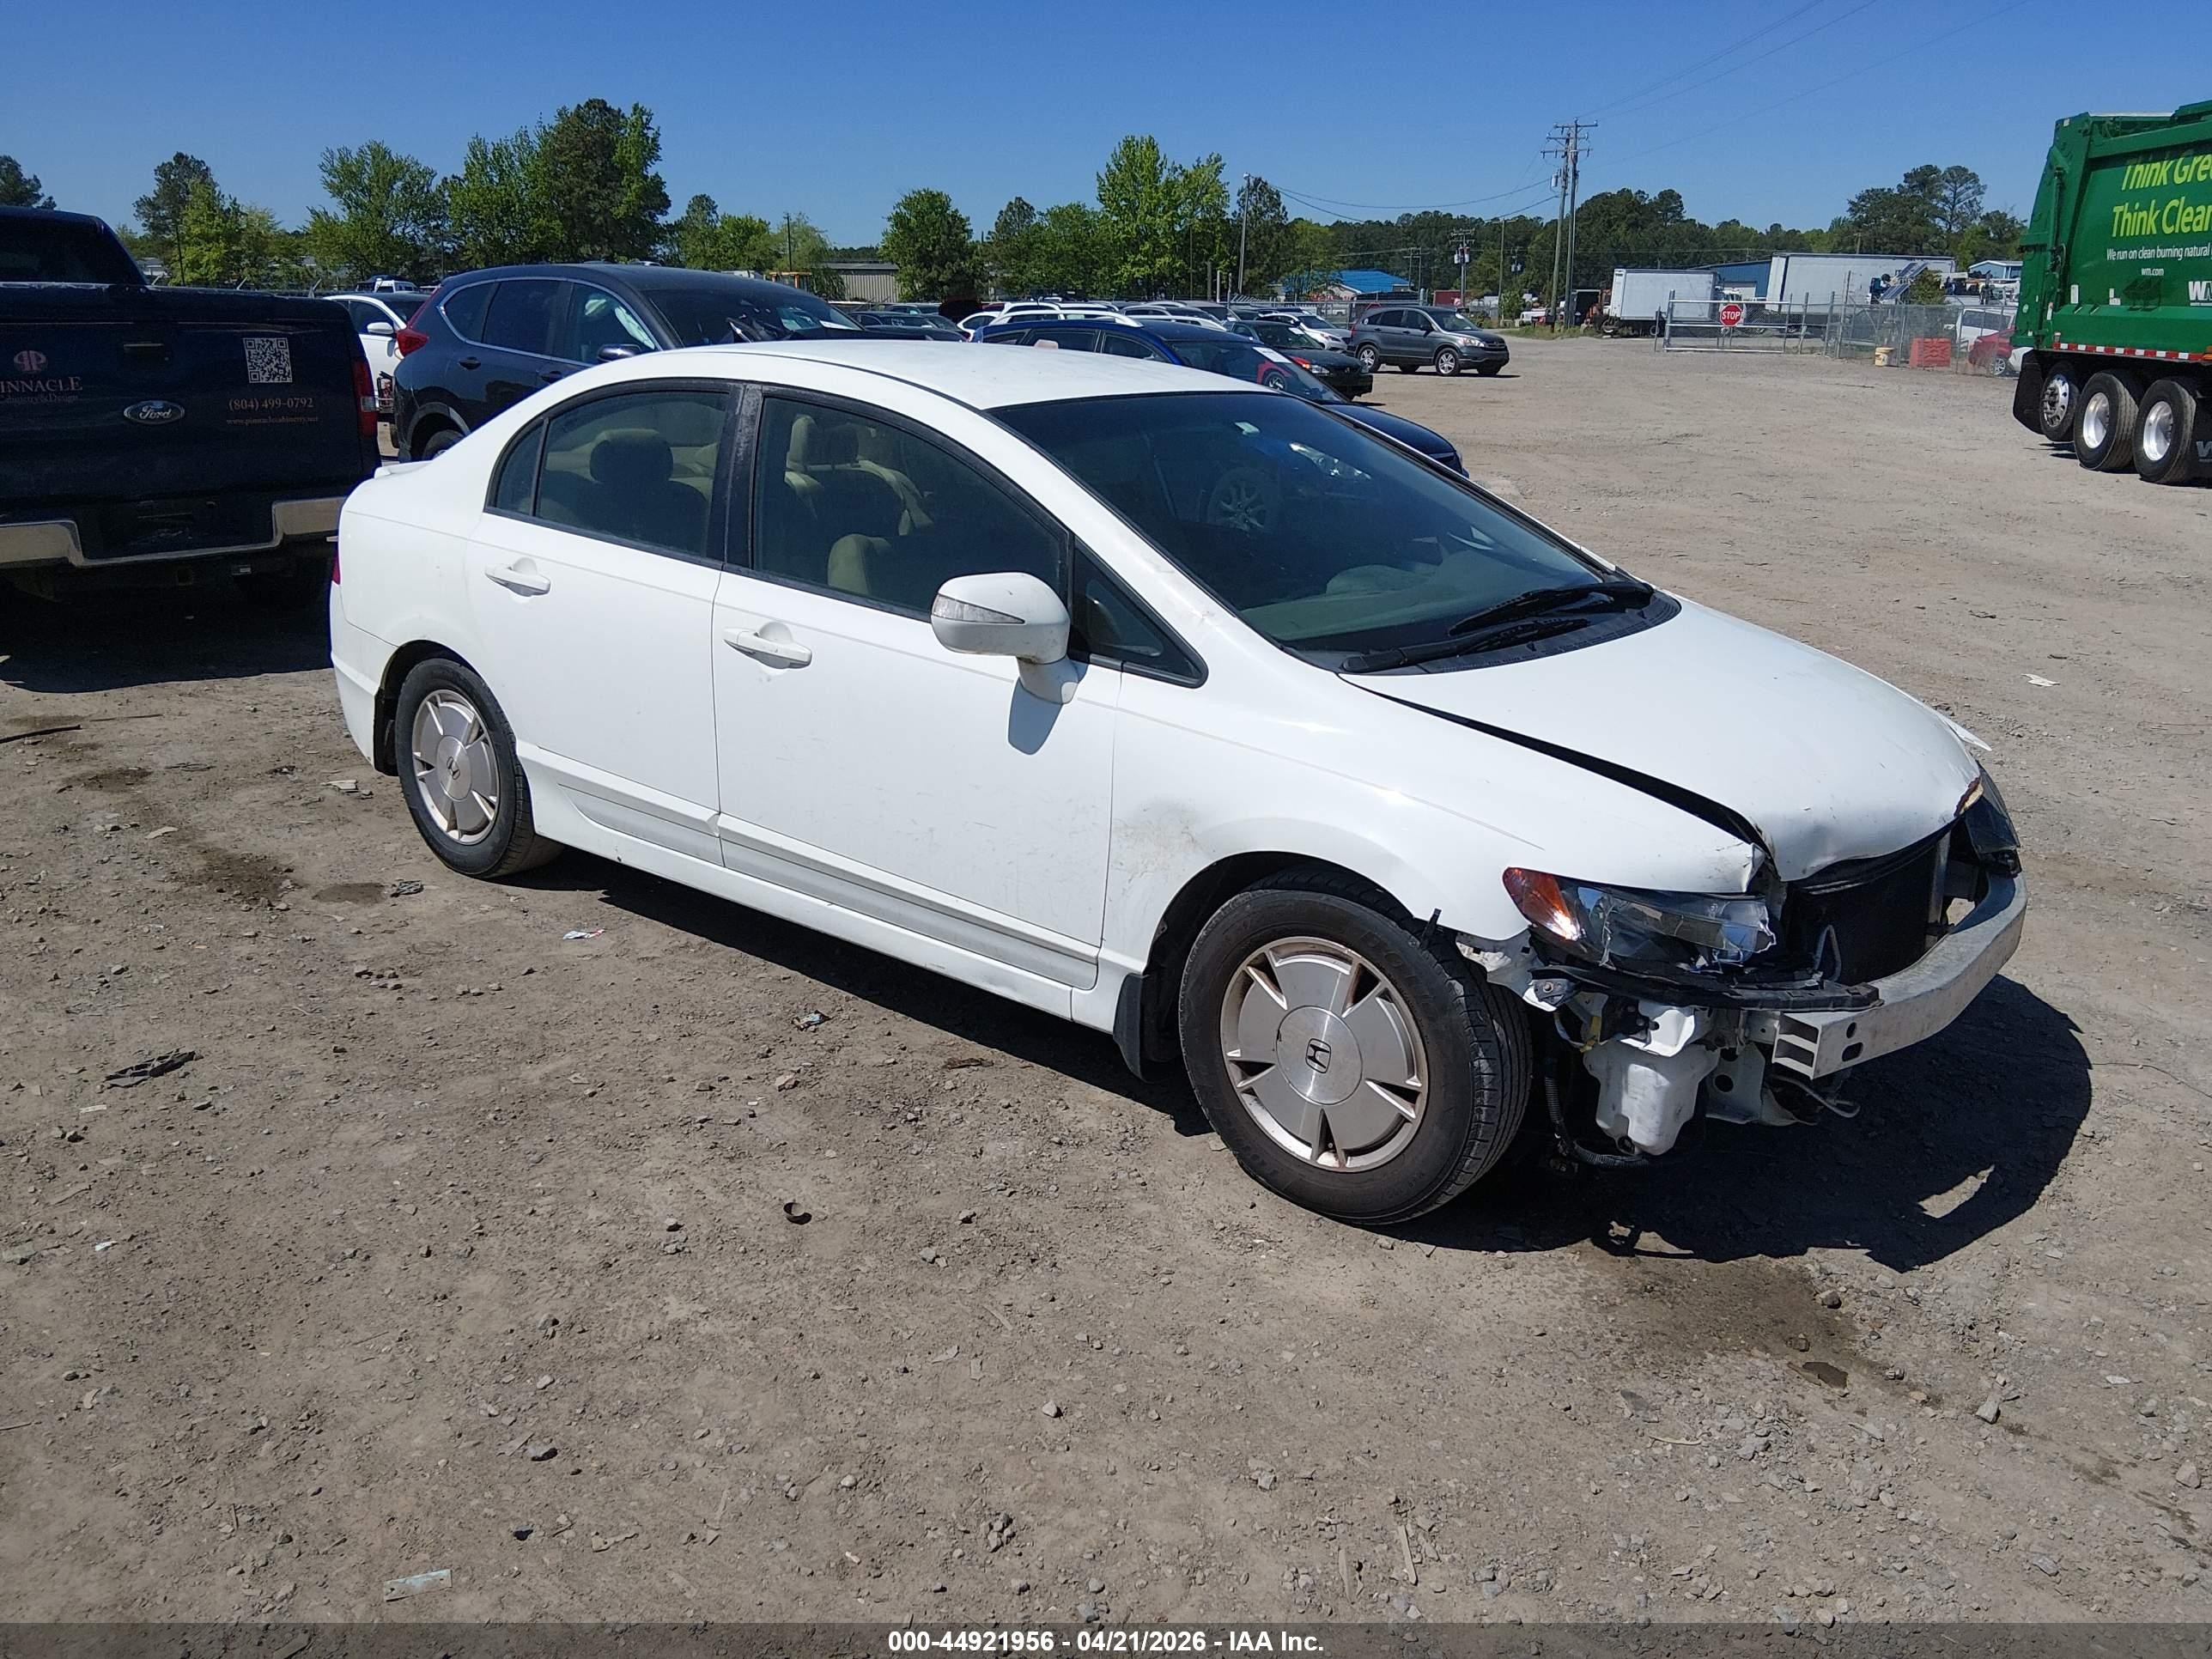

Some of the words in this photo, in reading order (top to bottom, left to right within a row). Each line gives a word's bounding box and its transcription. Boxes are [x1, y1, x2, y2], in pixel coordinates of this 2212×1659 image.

[2121, 153, 2176, 191] Think
[2173, 151, 2212, 185] Gre
[2112, 199, 2160, 237] Think
[2106, 248, 2117, 260] We
[2117, 249, 2128, 260] run
[2128, 248, 2137, 259] on
[2138, 246, 2155, 258] clean
[2156, 246, 2183, 260] burning
[2184, 242, 2210, 258] natural
[1722, 311, 1741, 320] STOP
[138, 405, 173, 420] Ford
[228, 398, 259, 411] (804)
[261, 398, 314, 409] 499-0792
